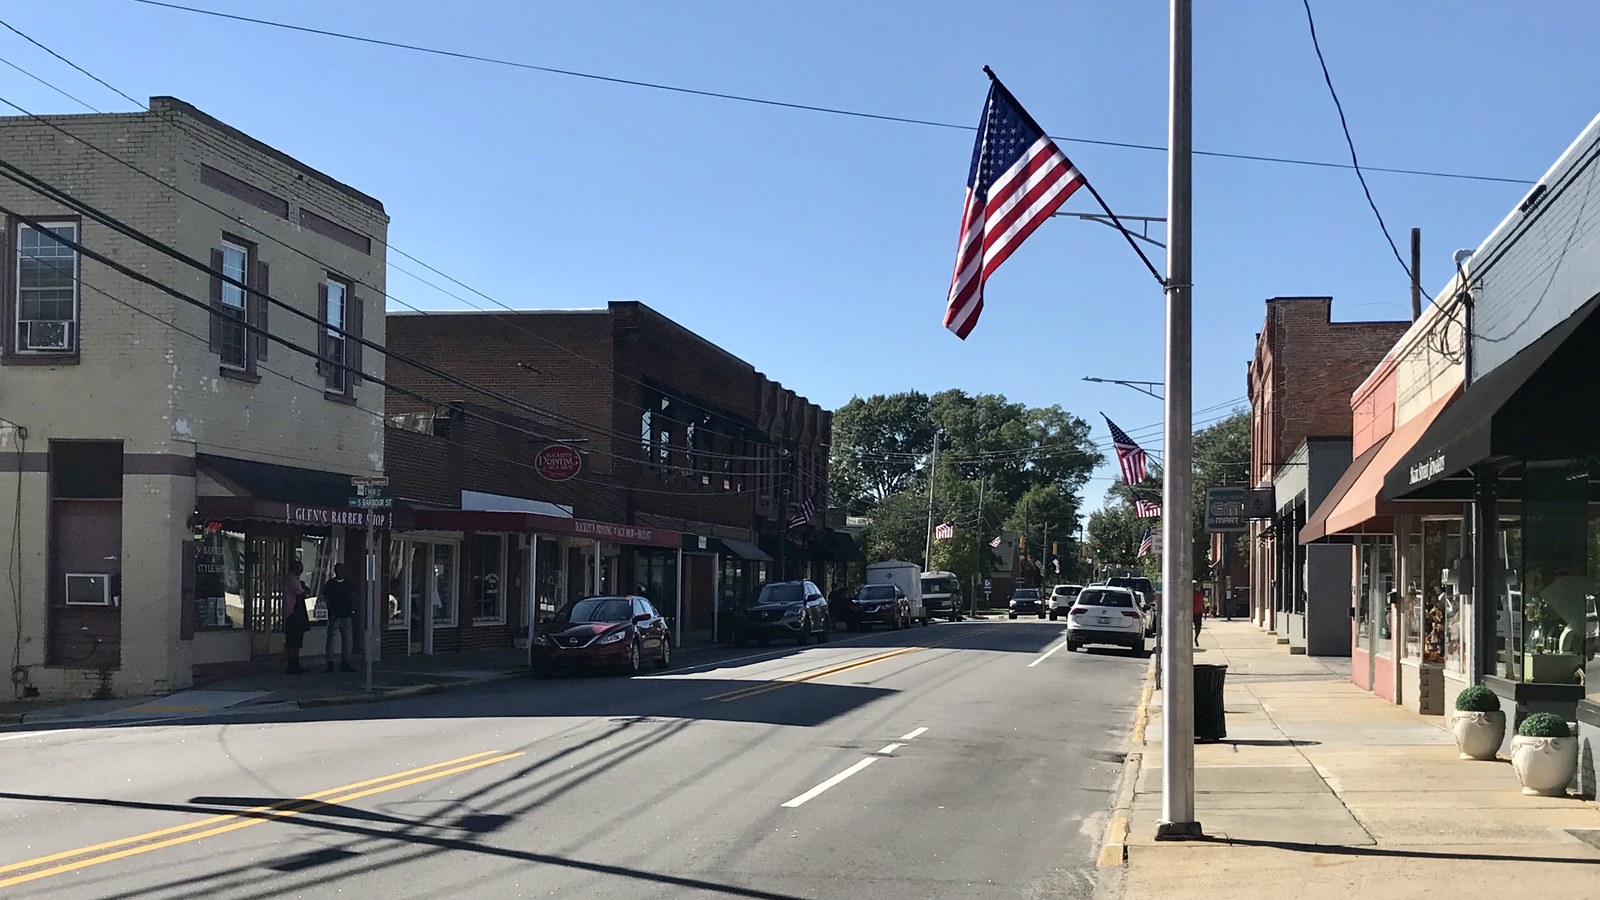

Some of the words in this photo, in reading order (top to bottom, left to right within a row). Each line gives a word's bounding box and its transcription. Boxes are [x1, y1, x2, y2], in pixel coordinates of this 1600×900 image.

[538, 455, 579, 465] PRINTING
[1419, 460, 1428, 479] Street
[1428, 450, 1445, 480] Jewelers
[357, 498, 362, 507] S
[362, 498, 385, 507] BARBOUR
[385, 498, 392, 507] ST
[295, 507, 328, 522] GLEN'S
[331, 511, 363, 525] BARBER
[197, 563, 214, 573] STYLE
